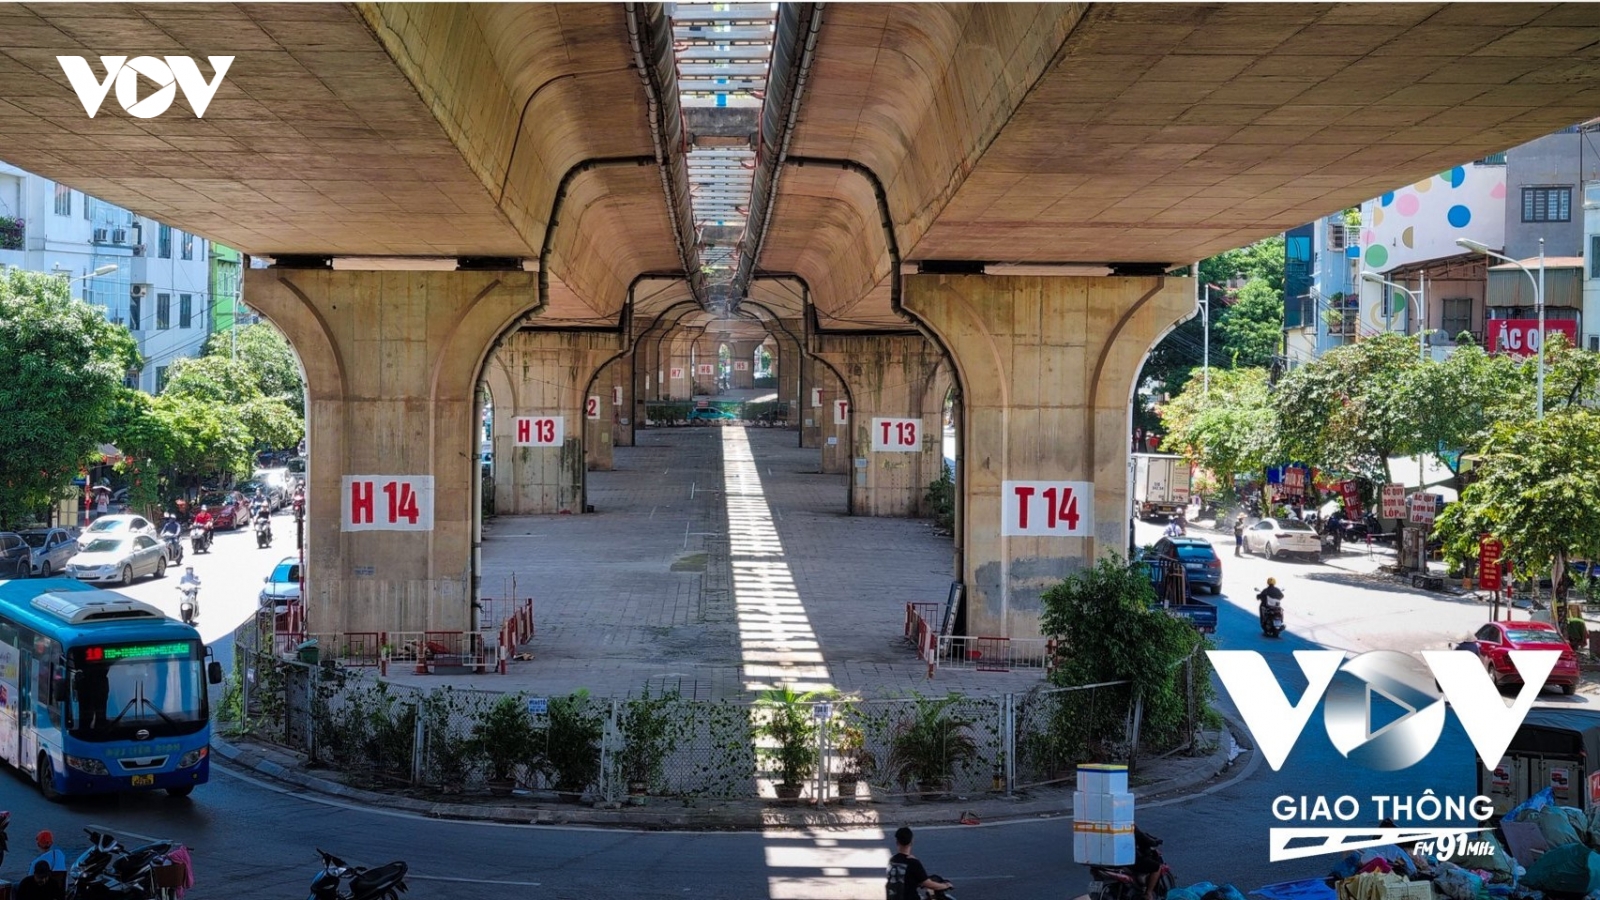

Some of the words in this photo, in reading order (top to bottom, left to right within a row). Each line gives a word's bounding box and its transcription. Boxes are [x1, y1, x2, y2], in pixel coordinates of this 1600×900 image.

[518, 419, 530, 443] H
[535, 419, 555, 443] 13
[881, 422, 891, 445] T
[896, 422, 916, 446] 13
[352, 481, 374, 524] H
[383, 481, 420, 525] 14
[1014, 486, 1035, 529] T
[1042, 487, 1080, 530] 14
